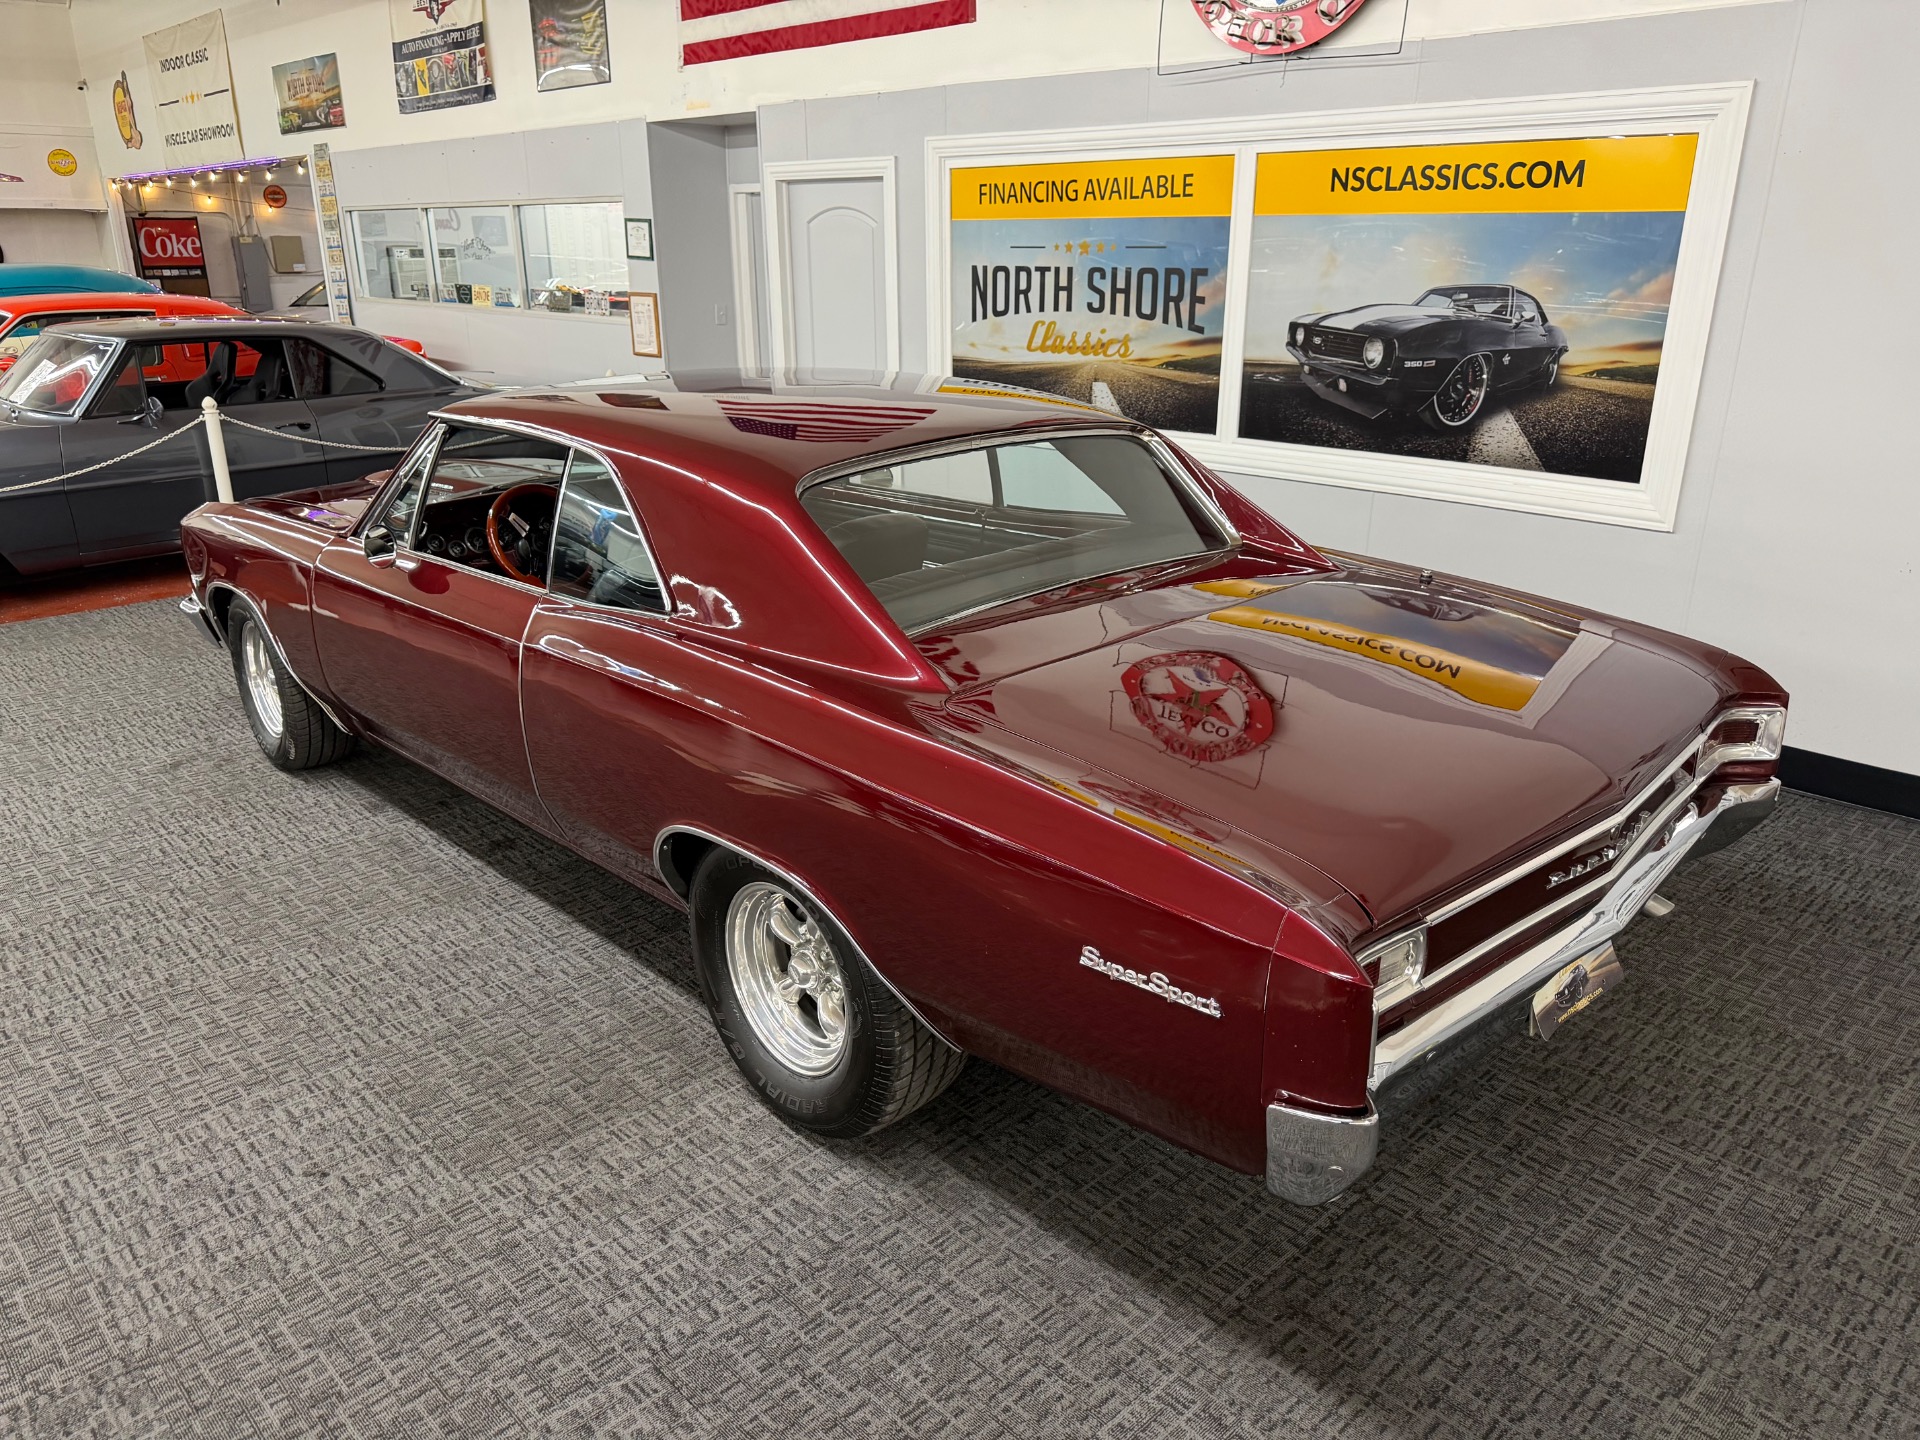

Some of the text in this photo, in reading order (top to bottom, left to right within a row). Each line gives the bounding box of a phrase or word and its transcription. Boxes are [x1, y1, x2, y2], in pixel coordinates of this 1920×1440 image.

[159, 48, 209, 73] INDOOR CLASSIC
[164, 122, 236, 148] MUSCLE CAR SHOWROOM
[978, 173, 1194, 205] FINANCING AVAILABLE
[1330, 159, 1586, 192] NSCLASSICS.COM
[138, 226, 202, 258] Coke
[971, 264, 1209, 335] NORTH SHORE
[1026, 319, 1134, 359] Classics
